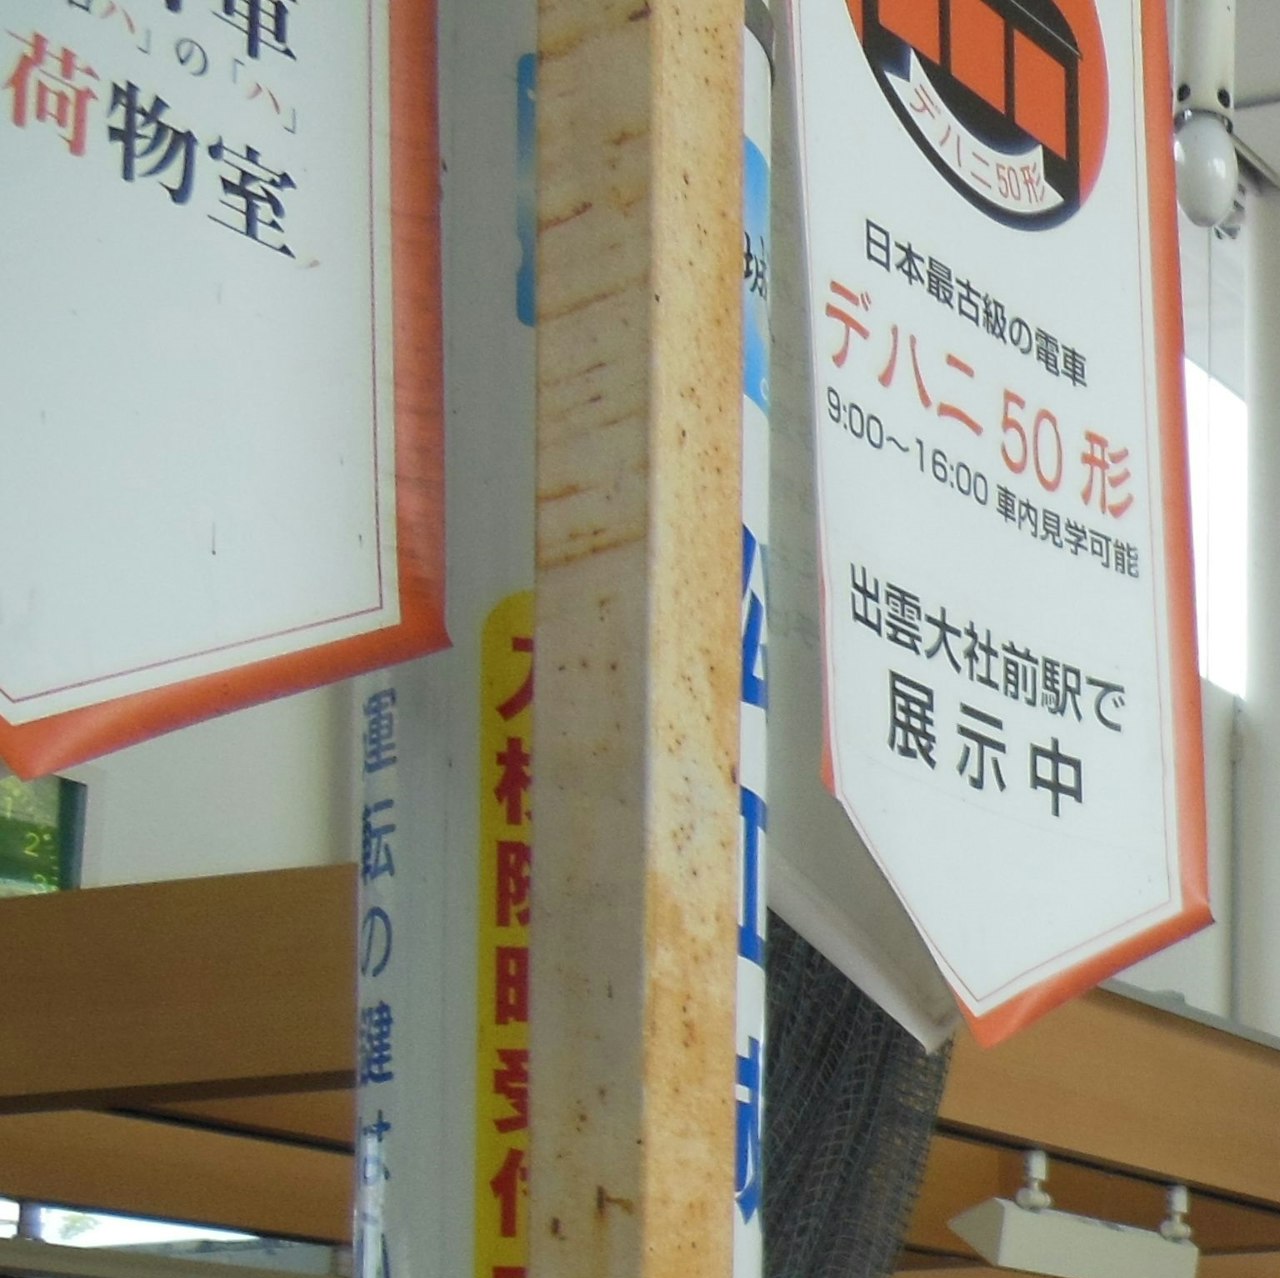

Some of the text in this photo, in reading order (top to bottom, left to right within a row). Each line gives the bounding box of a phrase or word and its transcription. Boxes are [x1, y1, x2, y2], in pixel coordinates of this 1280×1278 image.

[2, 30, 297, 260] 荷物室
[865, 217, 1088, 389] 日本最古級の電車
[995, 484, 1140, 579] 車内見学可能
[849, 561, 1126, 733] 出雲大社前駅で
[24, 832, 41, 857] 2
